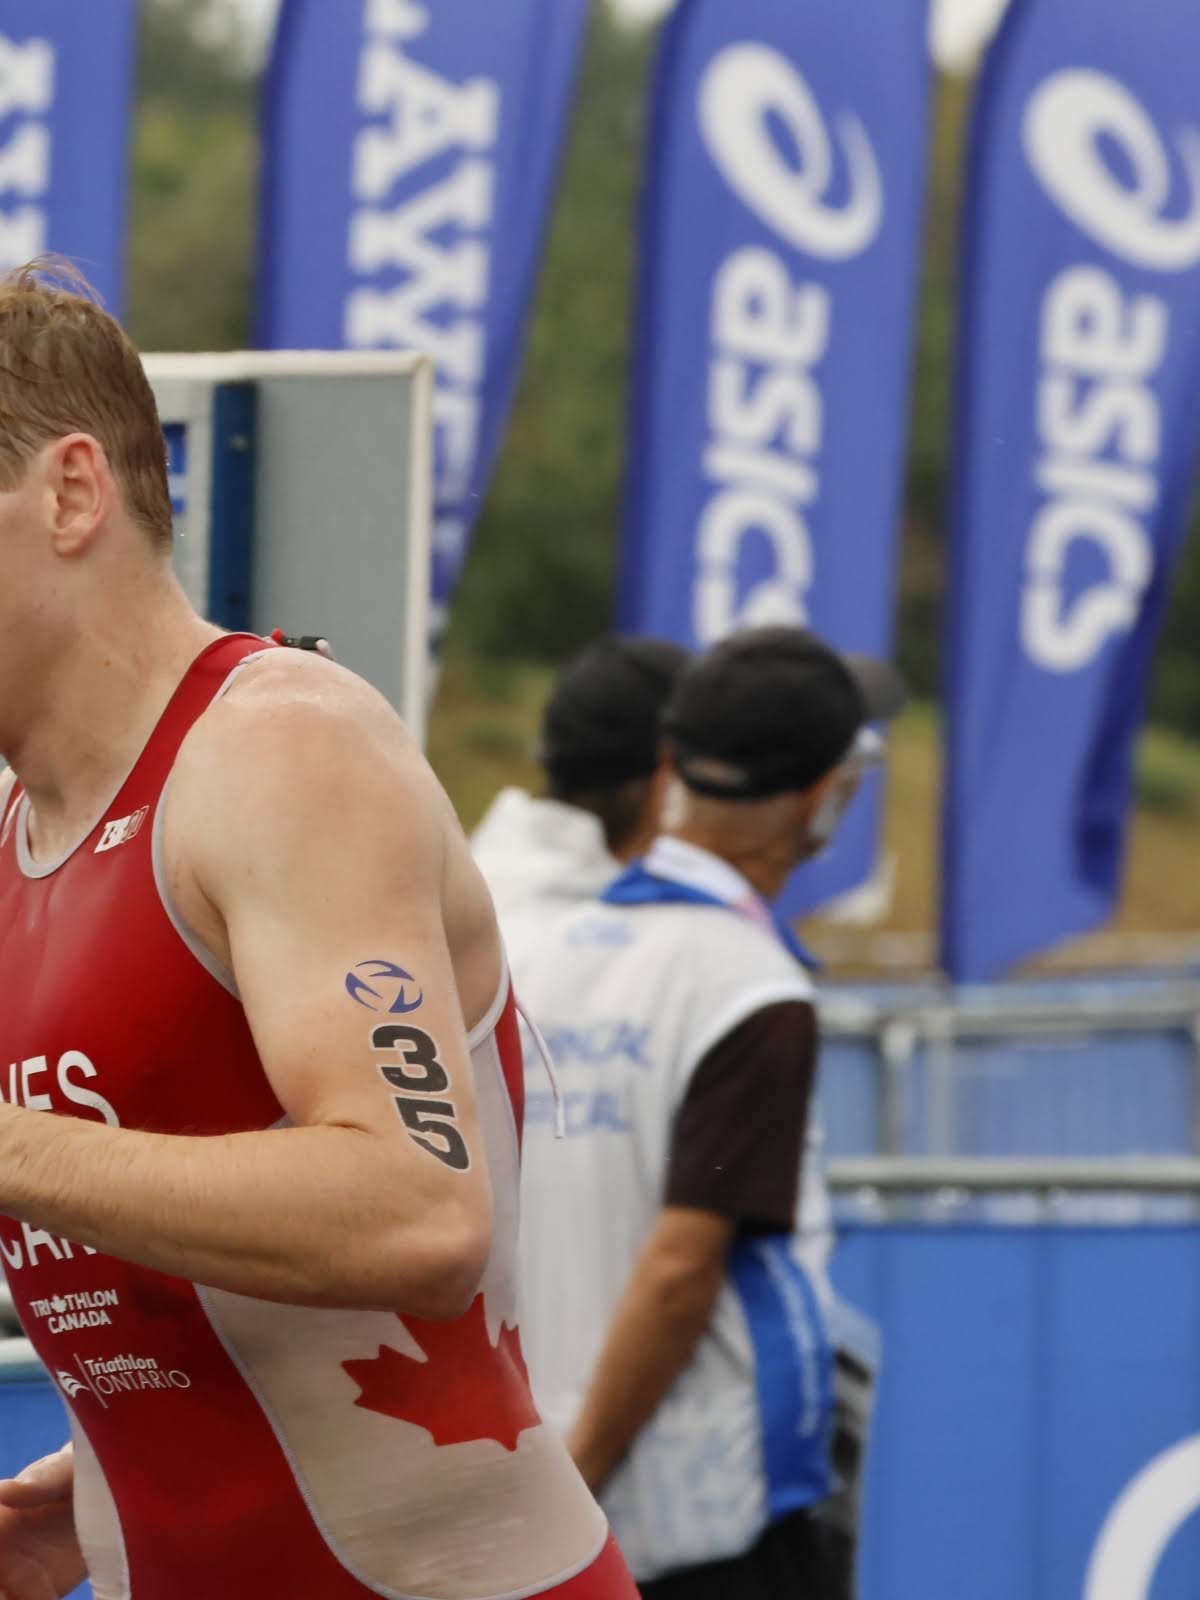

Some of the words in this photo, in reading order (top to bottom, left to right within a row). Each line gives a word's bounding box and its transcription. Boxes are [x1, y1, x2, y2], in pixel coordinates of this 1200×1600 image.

[1017, 264, 1169, 670] asics
[371, 1022, 471, 1173] 35
[47, 1309, 113, 1335] CANADA
[84, 1353, 159, 1377] Triathlon
[95, 1369, 192, 1395] ONTARIO
